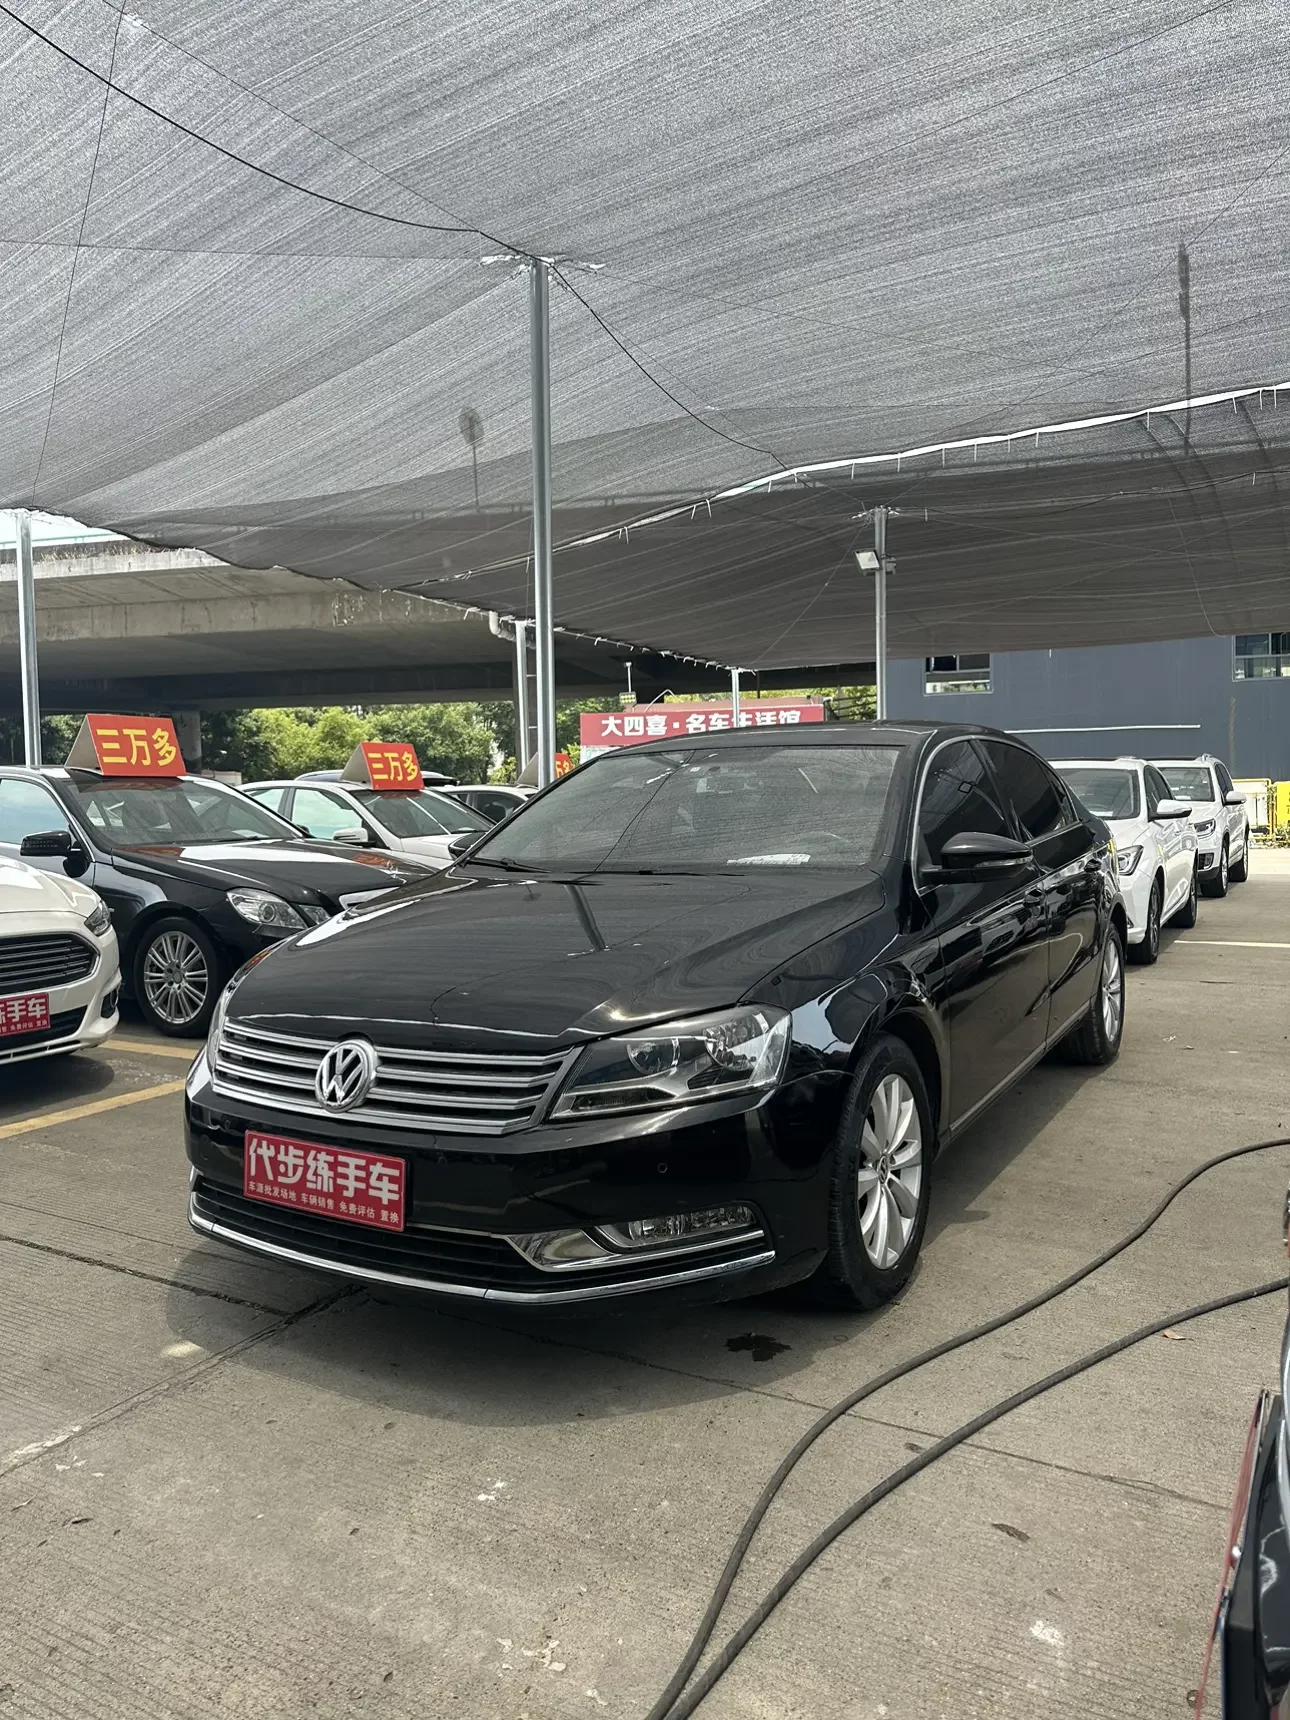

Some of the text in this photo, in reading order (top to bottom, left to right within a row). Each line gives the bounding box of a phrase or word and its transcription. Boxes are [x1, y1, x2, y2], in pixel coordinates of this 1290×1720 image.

[96, 727, 177, 767] 三万多
[367, 751, 419, 782] 三万多
[249, 1138, 400, 1206] 代步练手车
[248, 1181, 400, 1224] 车源批发场地 车辆销售 免费评估 置换
